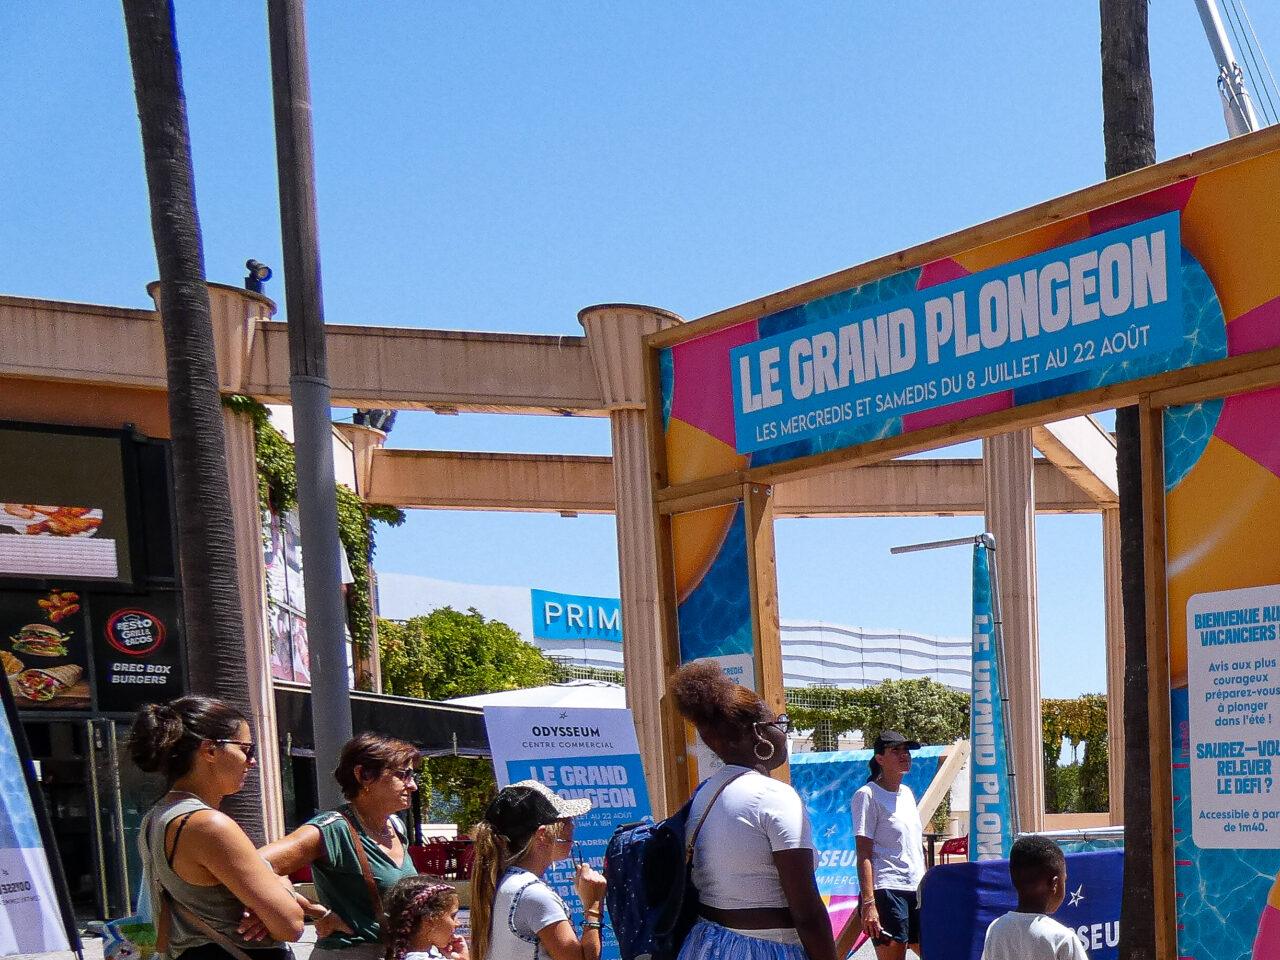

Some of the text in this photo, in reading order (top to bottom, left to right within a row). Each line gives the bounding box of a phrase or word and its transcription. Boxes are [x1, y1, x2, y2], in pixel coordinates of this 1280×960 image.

[739, 230, 1168, 414] LE GRAND PLONGEON
[756, 324, 1150, 442] LES MERCREDIS ET SAMEDIS DU 8 JUILLET AU 22 AOÛT
[544, 601, 620, 631] PRIM
[1194, 607, 1260, 630] BIENVENUE
[1200, 624, 1277, 647] VACANCIERS
[112, 662, 171, 674] GREC BOX
[1208, 657, 1277, 672] Avis aux plus
[111, 675, 167, 684] BURGERS
[1213, 673, 1269, 686] courageux
[1205, 686, 1280, 702] préparez-vous
[1227, 701, 1268, 714] plonger
[1214, 713, 1241, 727] dans
[532, 726, 601, 738] ODYSSEUM
[522, 741, 614, 749] CENTRE COMMERCIAL
[1217, 759, 1272, 776] RELEVER
[560, 765, 629, 787] GRAND
[1217, 777, 1232, 794] LE
[1264, 777, 1273, 793] ?
[975, 773, 1003, 861] PLON
[1199, 809, 1250, 820] Accessible
[1252, 809, 1260, 819] à
[1224, 822, 1268, 832] de 1m40.
